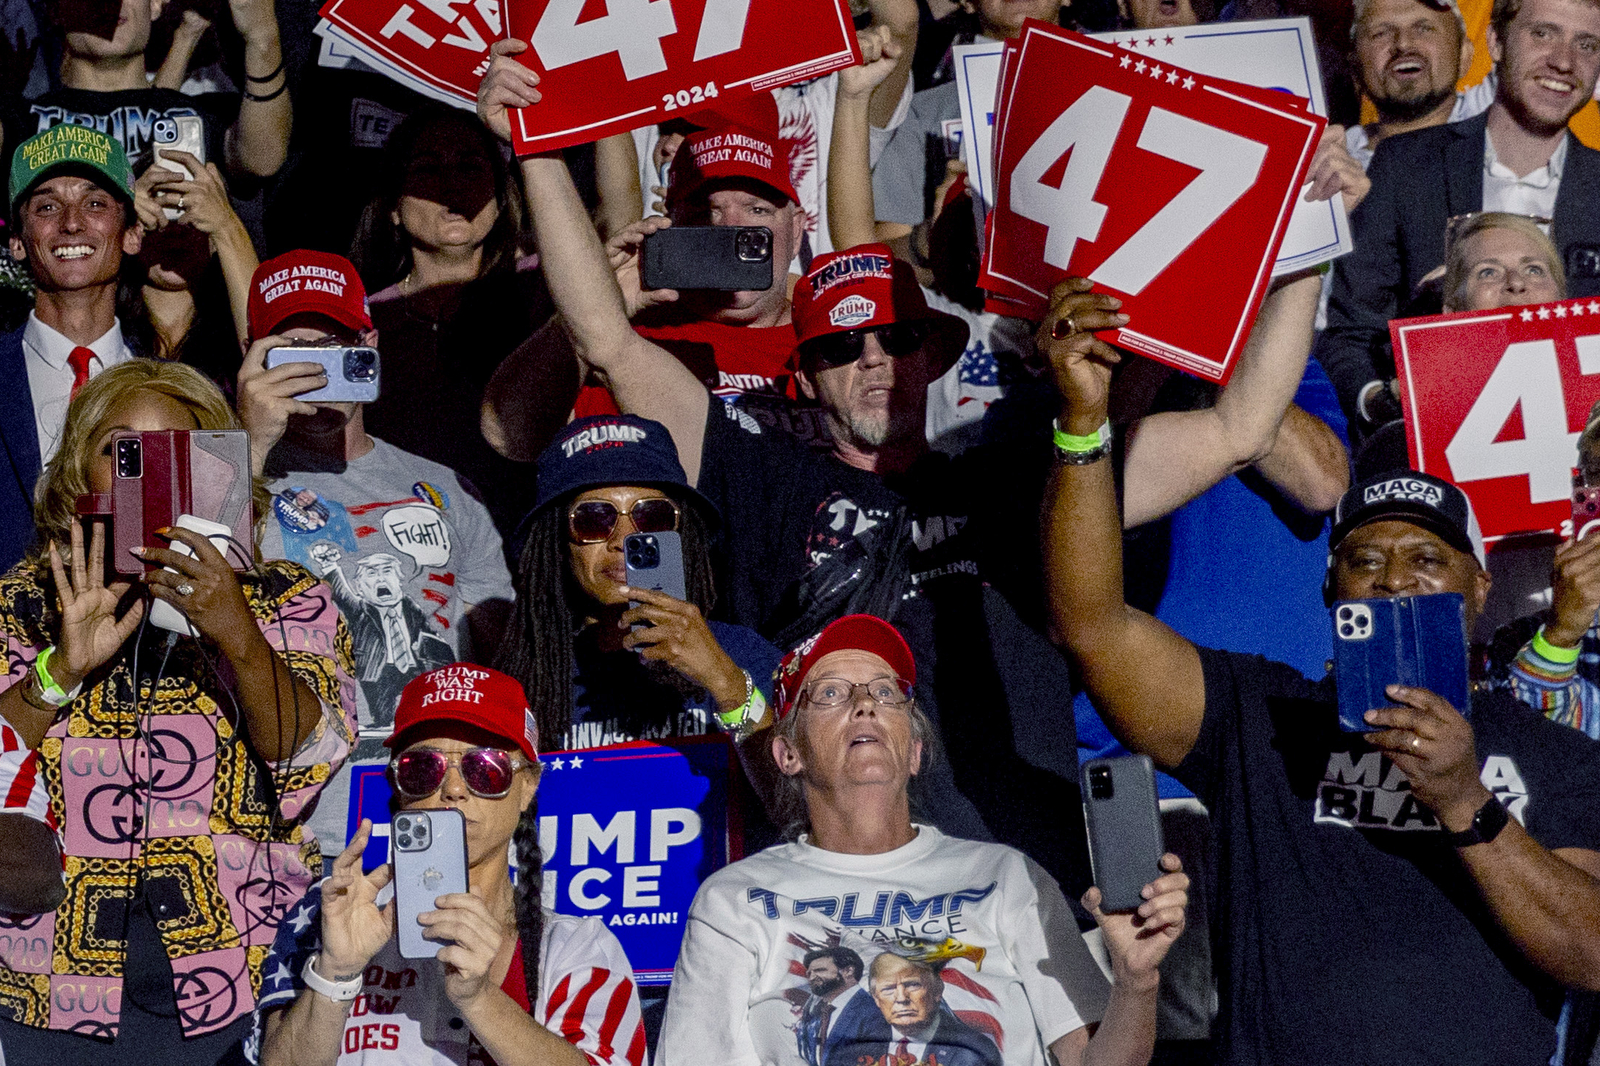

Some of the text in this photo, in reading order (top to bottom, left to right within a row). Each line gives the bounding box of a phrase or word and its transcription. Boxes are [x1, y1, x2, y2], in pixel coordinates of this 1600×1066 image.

[472, 55, 491, 77] MA
[661, 81, 719, 111] 2024
[22, 126, 112, 159] MAKE AMERICA
[689, 134, 774, 157] MAKE AMERICA
[29, 144, 108, 170] GREAT AGAIN
[734, 149, 772, 170] AGAIN
[1010, 84, 1269, 296] 47
[259, 265, 347, 294] MAKE AMERICA
[810, 256, 892, 291] TRUMP
[265, 279, 343, 303] GREAT AGAIN
[830, 301, 874, 320] TRUMP
[719, 371, 764, 389] AUTO
[561, 424, 647, 458] TRUMP
[1366, 478, 1442, 500] MAGA
[278, 499, 309, 524] TRUMP
[389, 520, 448, 550] FIGHT!
[425, 667, 490, 684] TRUMP
[435, 676, 474, 690] WAS
[421, 688, 485, 708] RIGHT
[608, 911, 679, 926] AGAIN!
[859, 913, 968, 942] ANCE
[365, 965, 419, 990] ONT
[55, 982, 122, 1015] GUC
[348, 994, 401, 1018] OW
[340, 1023, 401, 1055] OES
